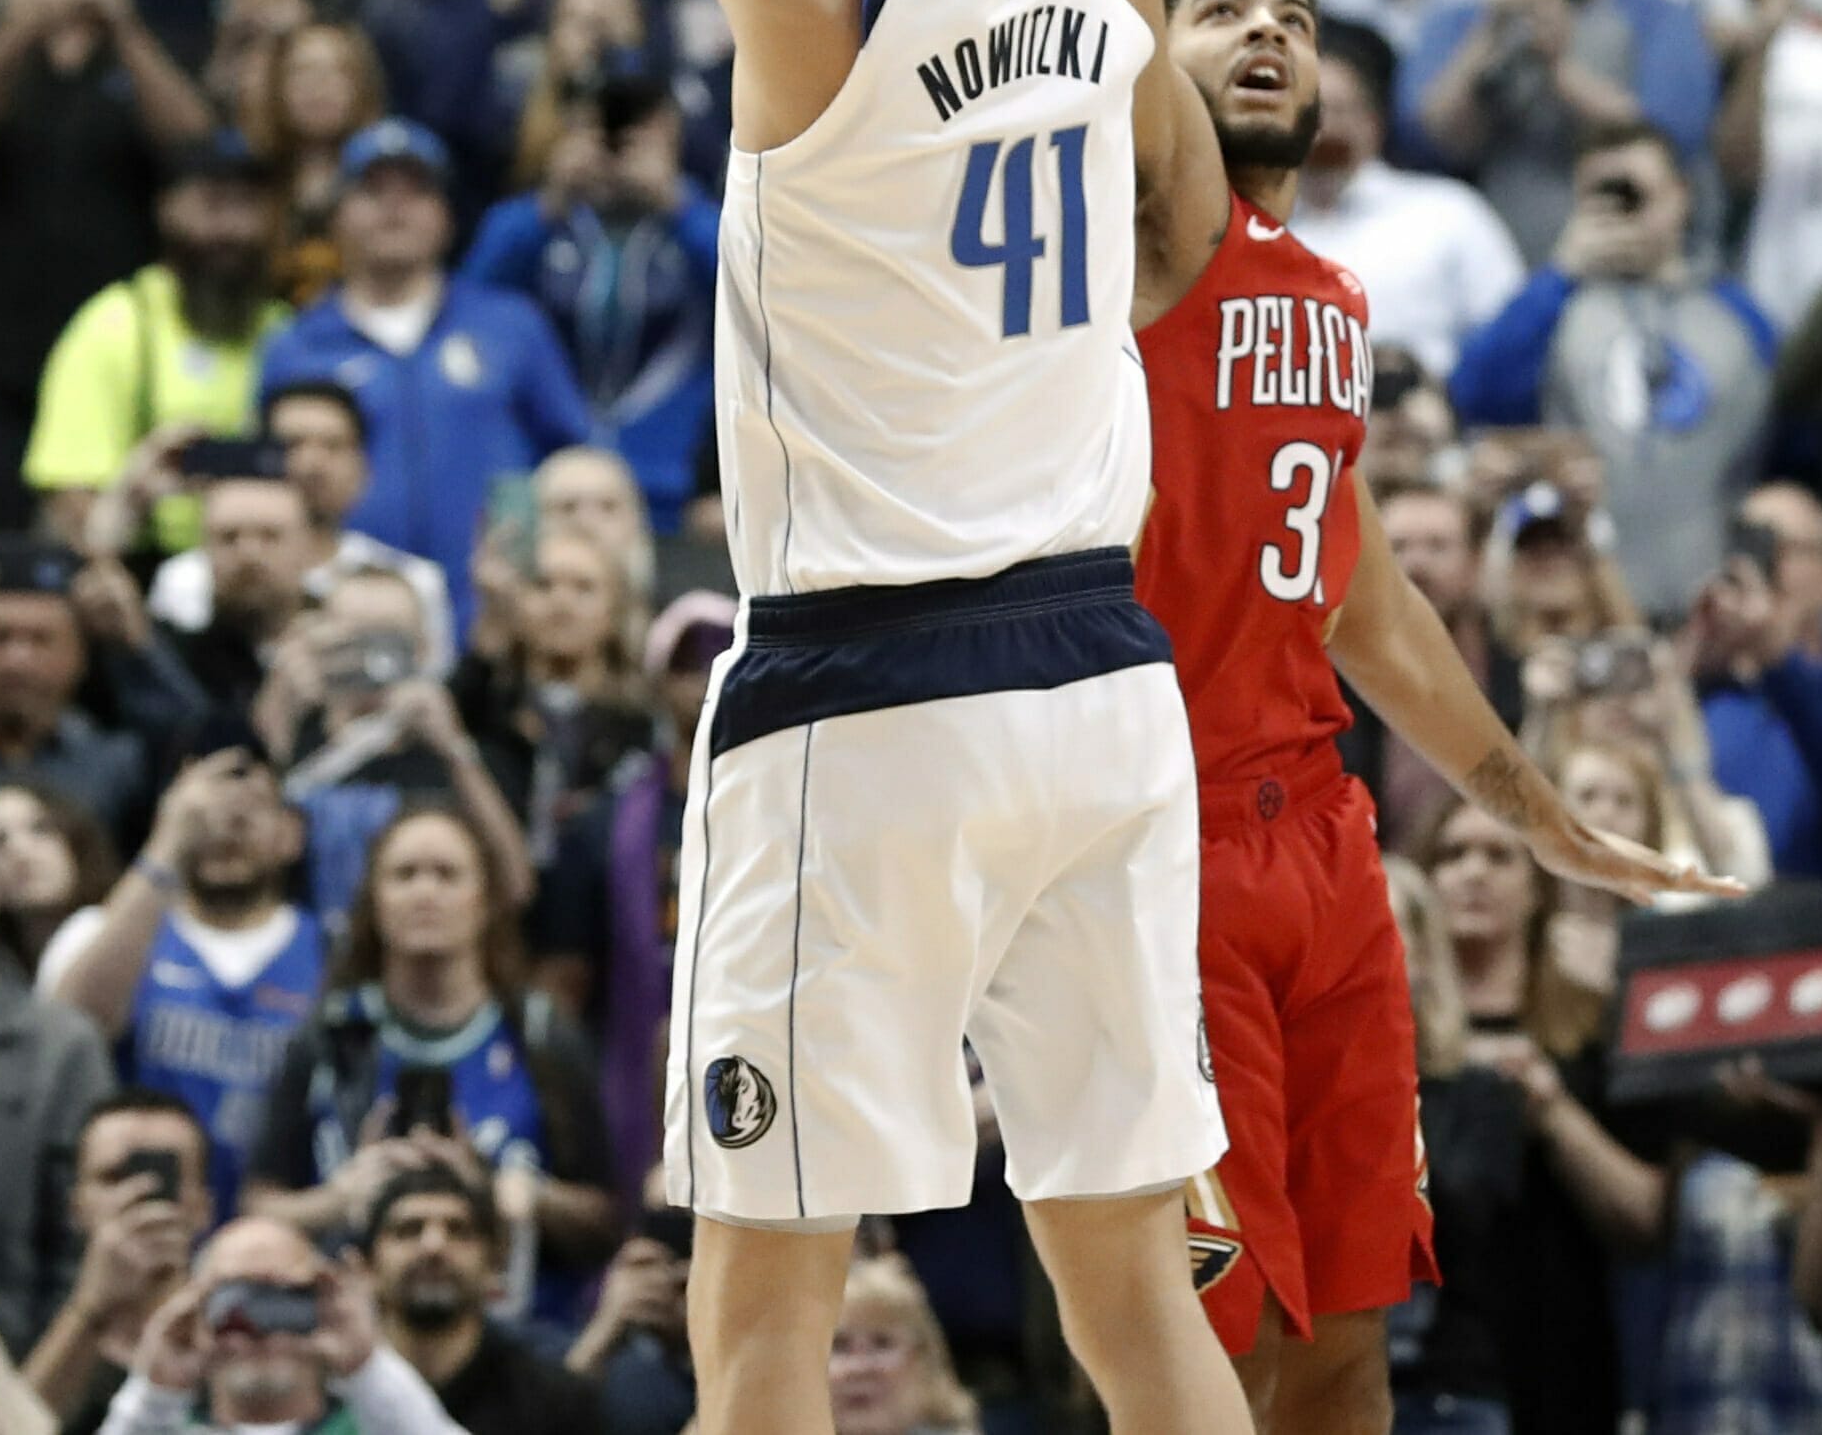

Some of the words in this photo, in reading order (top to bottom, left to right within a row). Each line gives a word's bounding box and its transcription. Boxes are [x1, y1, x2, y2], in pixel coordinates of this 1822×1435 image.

[916, 6, 1108, 123] NOWITZKI
[950, 124, 1090, 341] 41
[1216, 295, 1374, 420] PELICA
